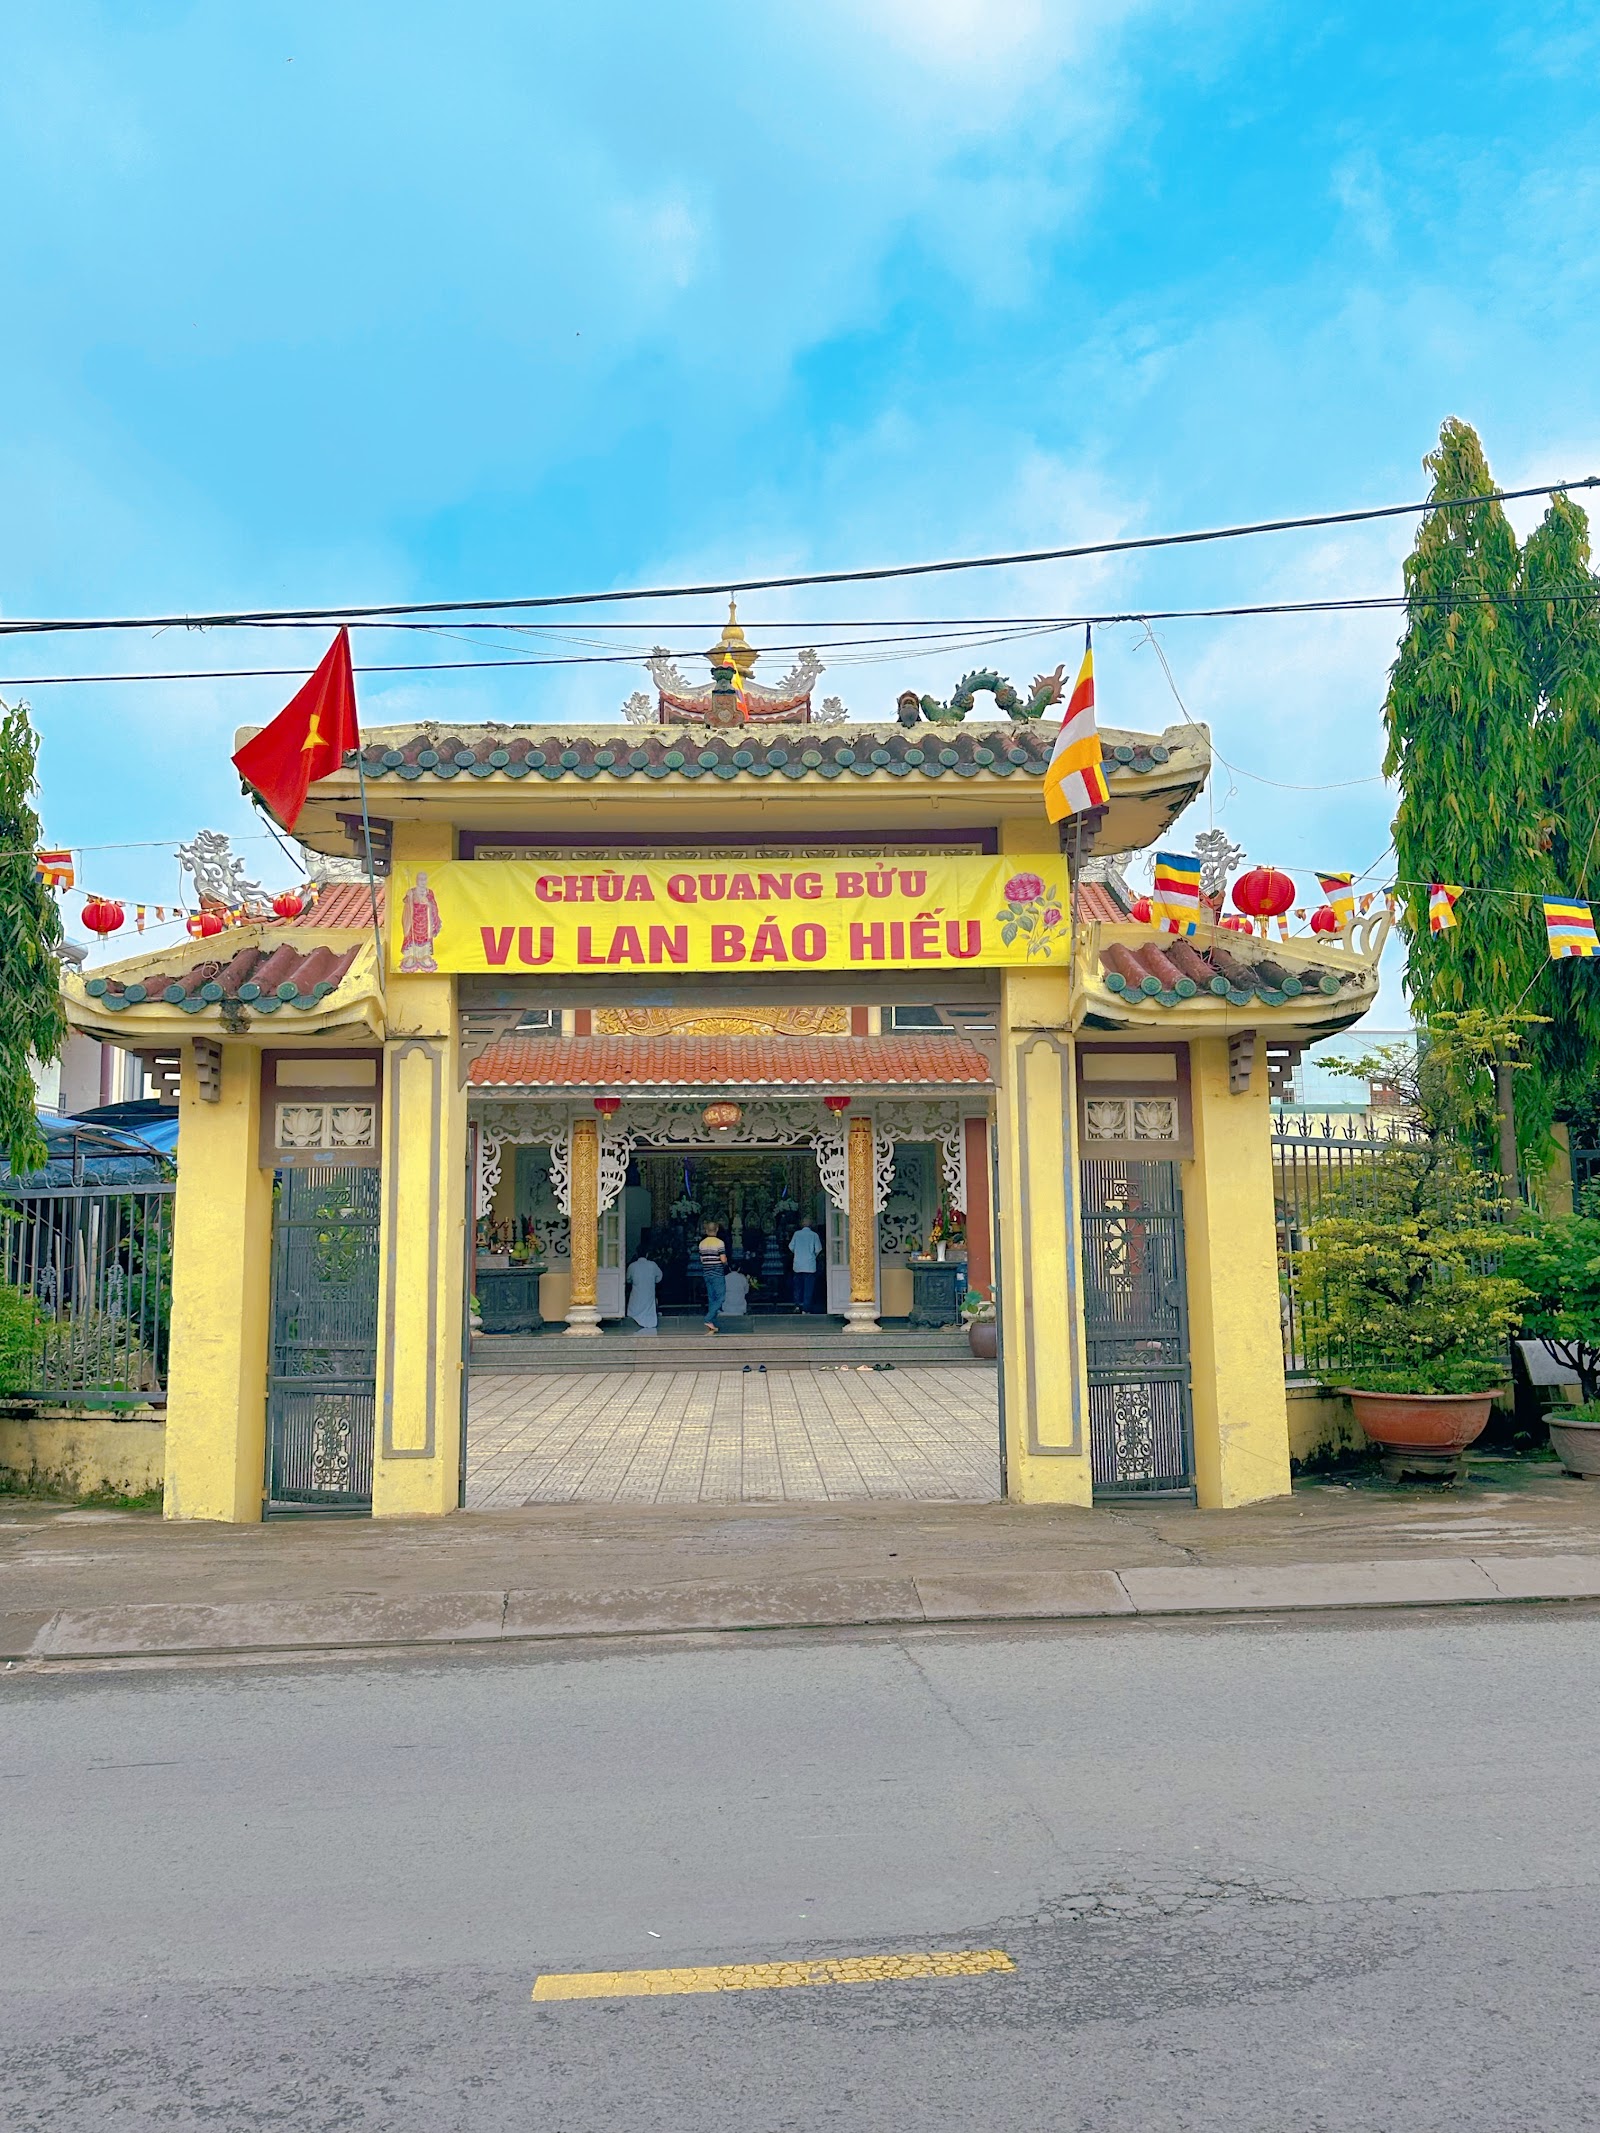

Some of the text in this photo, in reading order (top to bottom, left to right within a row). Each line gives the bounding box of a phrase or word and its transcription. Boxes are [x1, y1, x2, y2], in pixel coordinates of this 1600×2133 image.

[535, 862, 927, 903] CHÙA QUANG BỬU
[480, 907, 982, 966] VU LAN BÁO HIẾU
